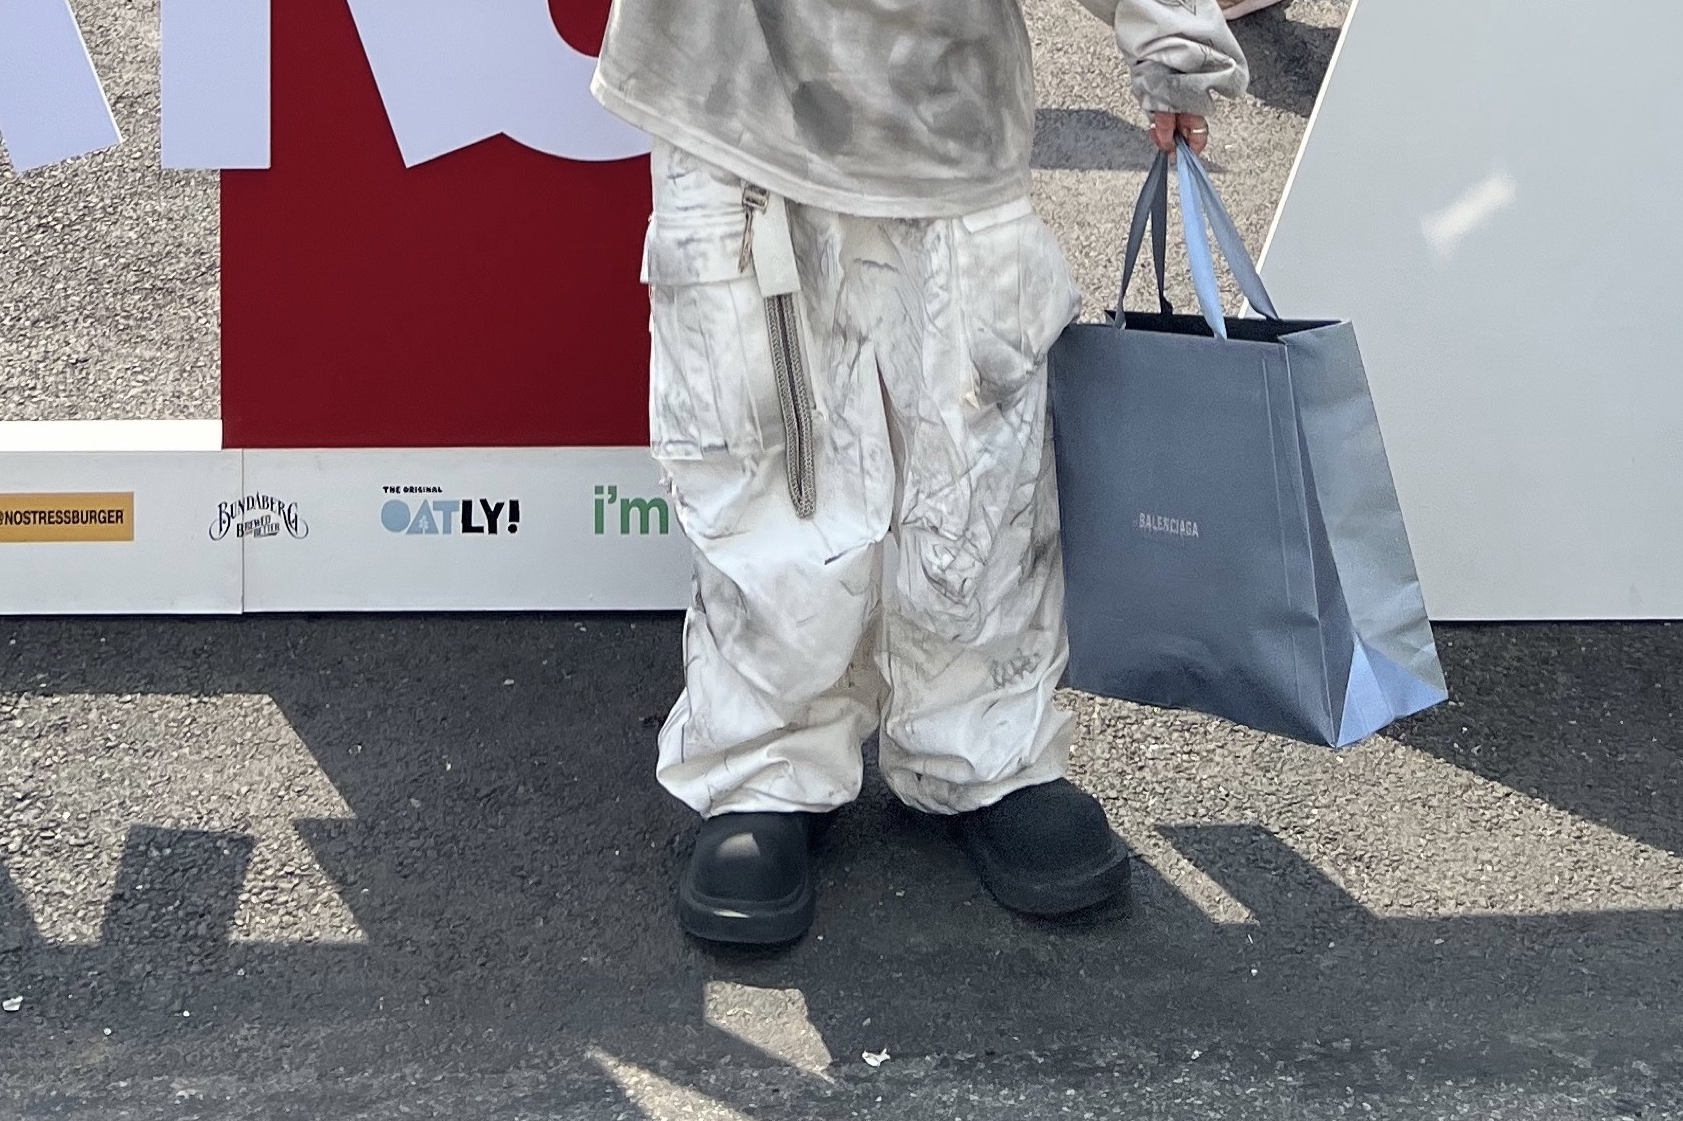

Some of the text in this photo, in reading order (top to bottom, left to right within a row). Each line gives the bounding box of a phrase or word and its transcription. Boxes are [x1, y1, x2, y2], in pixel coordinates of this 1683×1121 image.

[382, 486, 443, 494] THE ORIGINAL
[209, 490, 309, 541] BUNDABERG
[381, 498, 520, 535] OATLY!
[1139, 512, 1199, 538] BALENCIAGA
